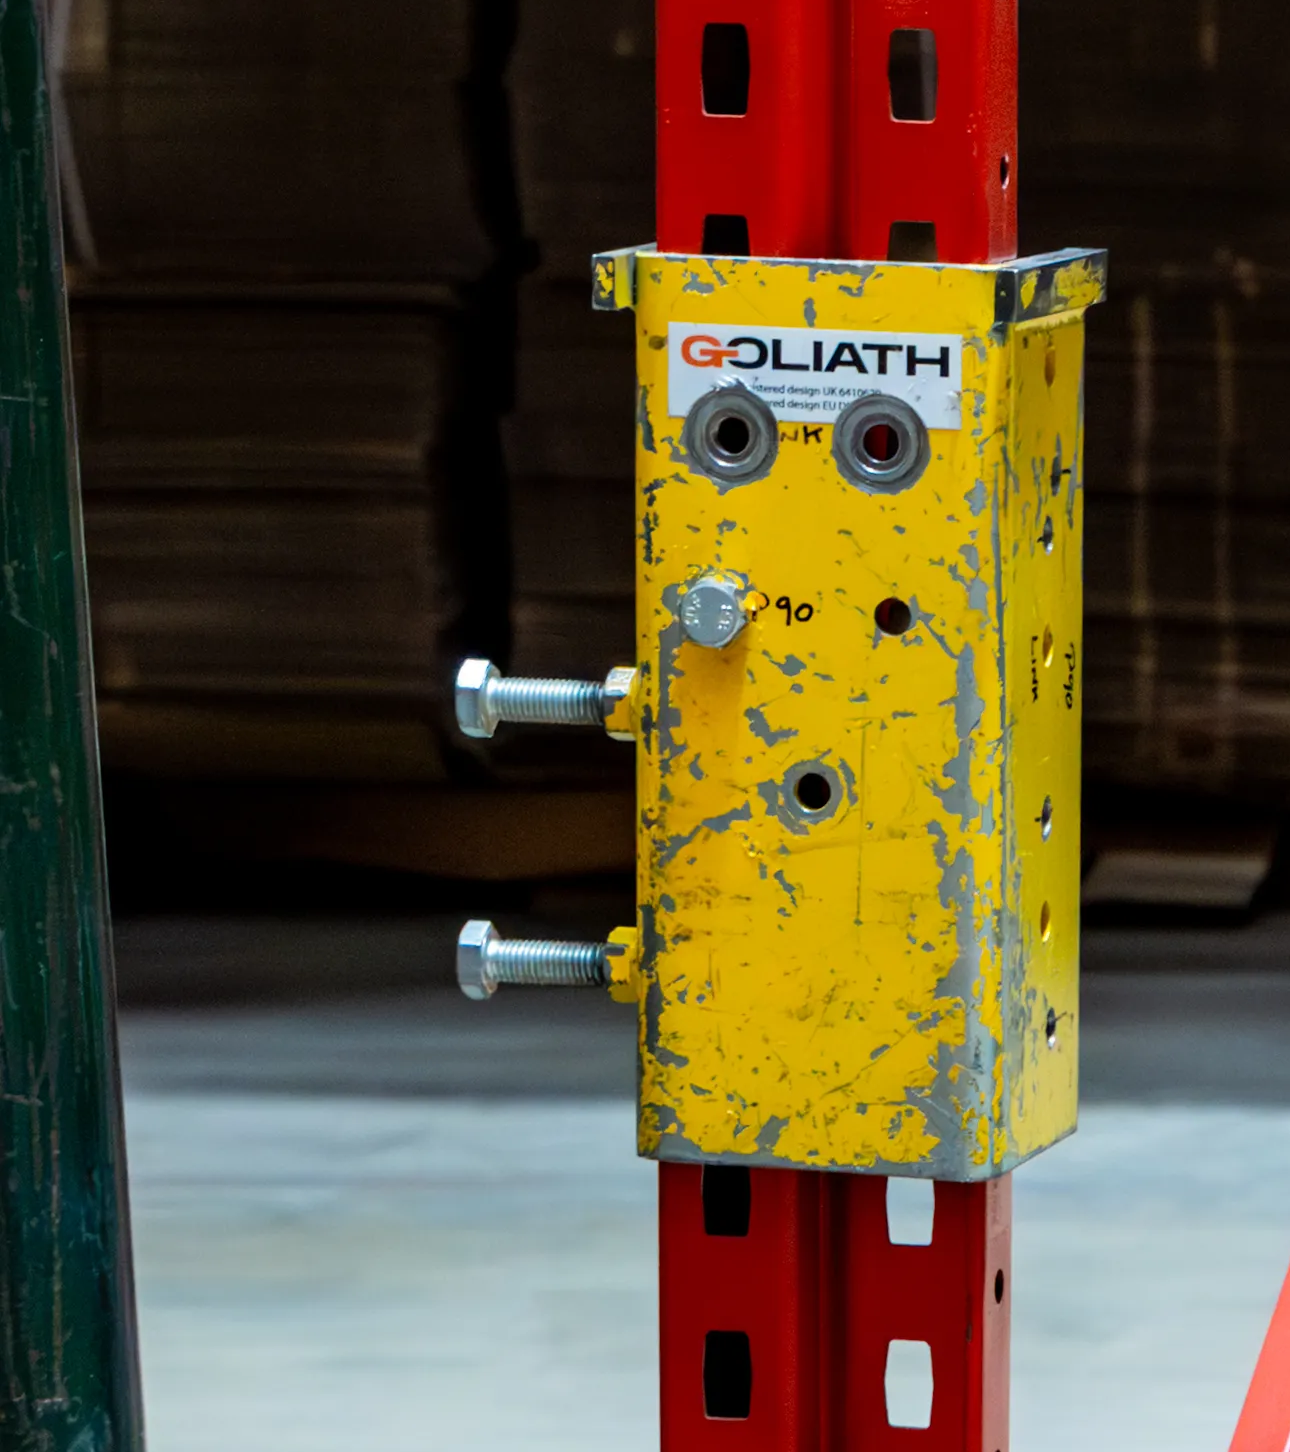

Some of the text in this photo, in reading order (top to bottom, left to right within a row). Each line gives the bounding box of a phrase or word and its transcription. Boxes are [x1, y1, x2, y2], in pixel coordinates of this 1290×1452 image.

[680, 334, 950, 378] GOLIATH
[787, 384, 820, 398] design
[822, 387, 837, 396] UK
[787, 399, 820, 411] design
[780, 425, 823, 445] NK
